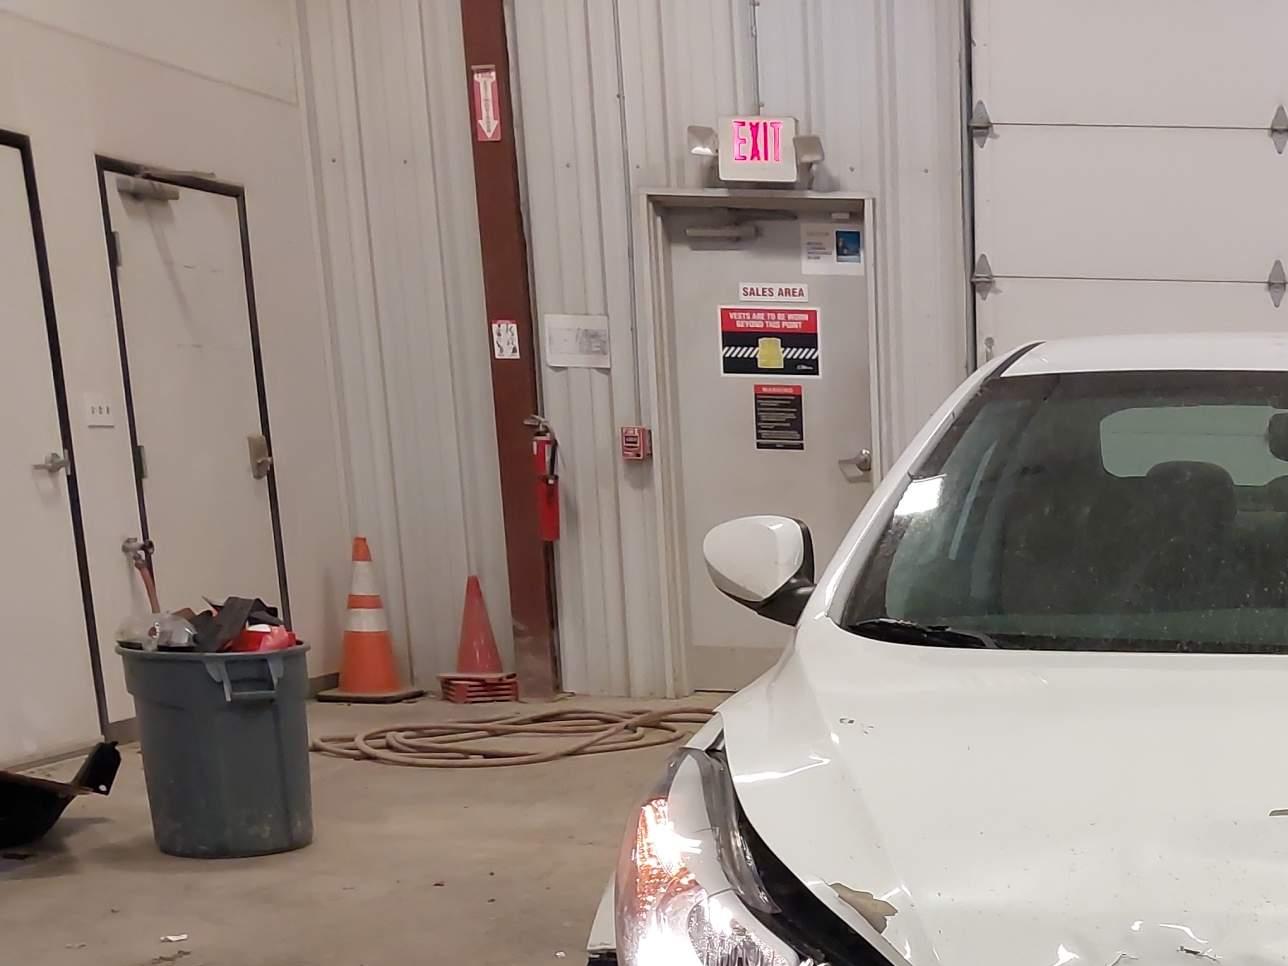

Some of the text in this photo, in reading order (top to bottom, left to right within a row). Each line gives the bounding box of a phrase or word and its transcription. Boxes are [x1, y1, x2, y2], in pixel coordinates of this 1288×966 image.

[732, 120, 782, 161] EXIT
[742, 286, 804, 297] SALES AREA
